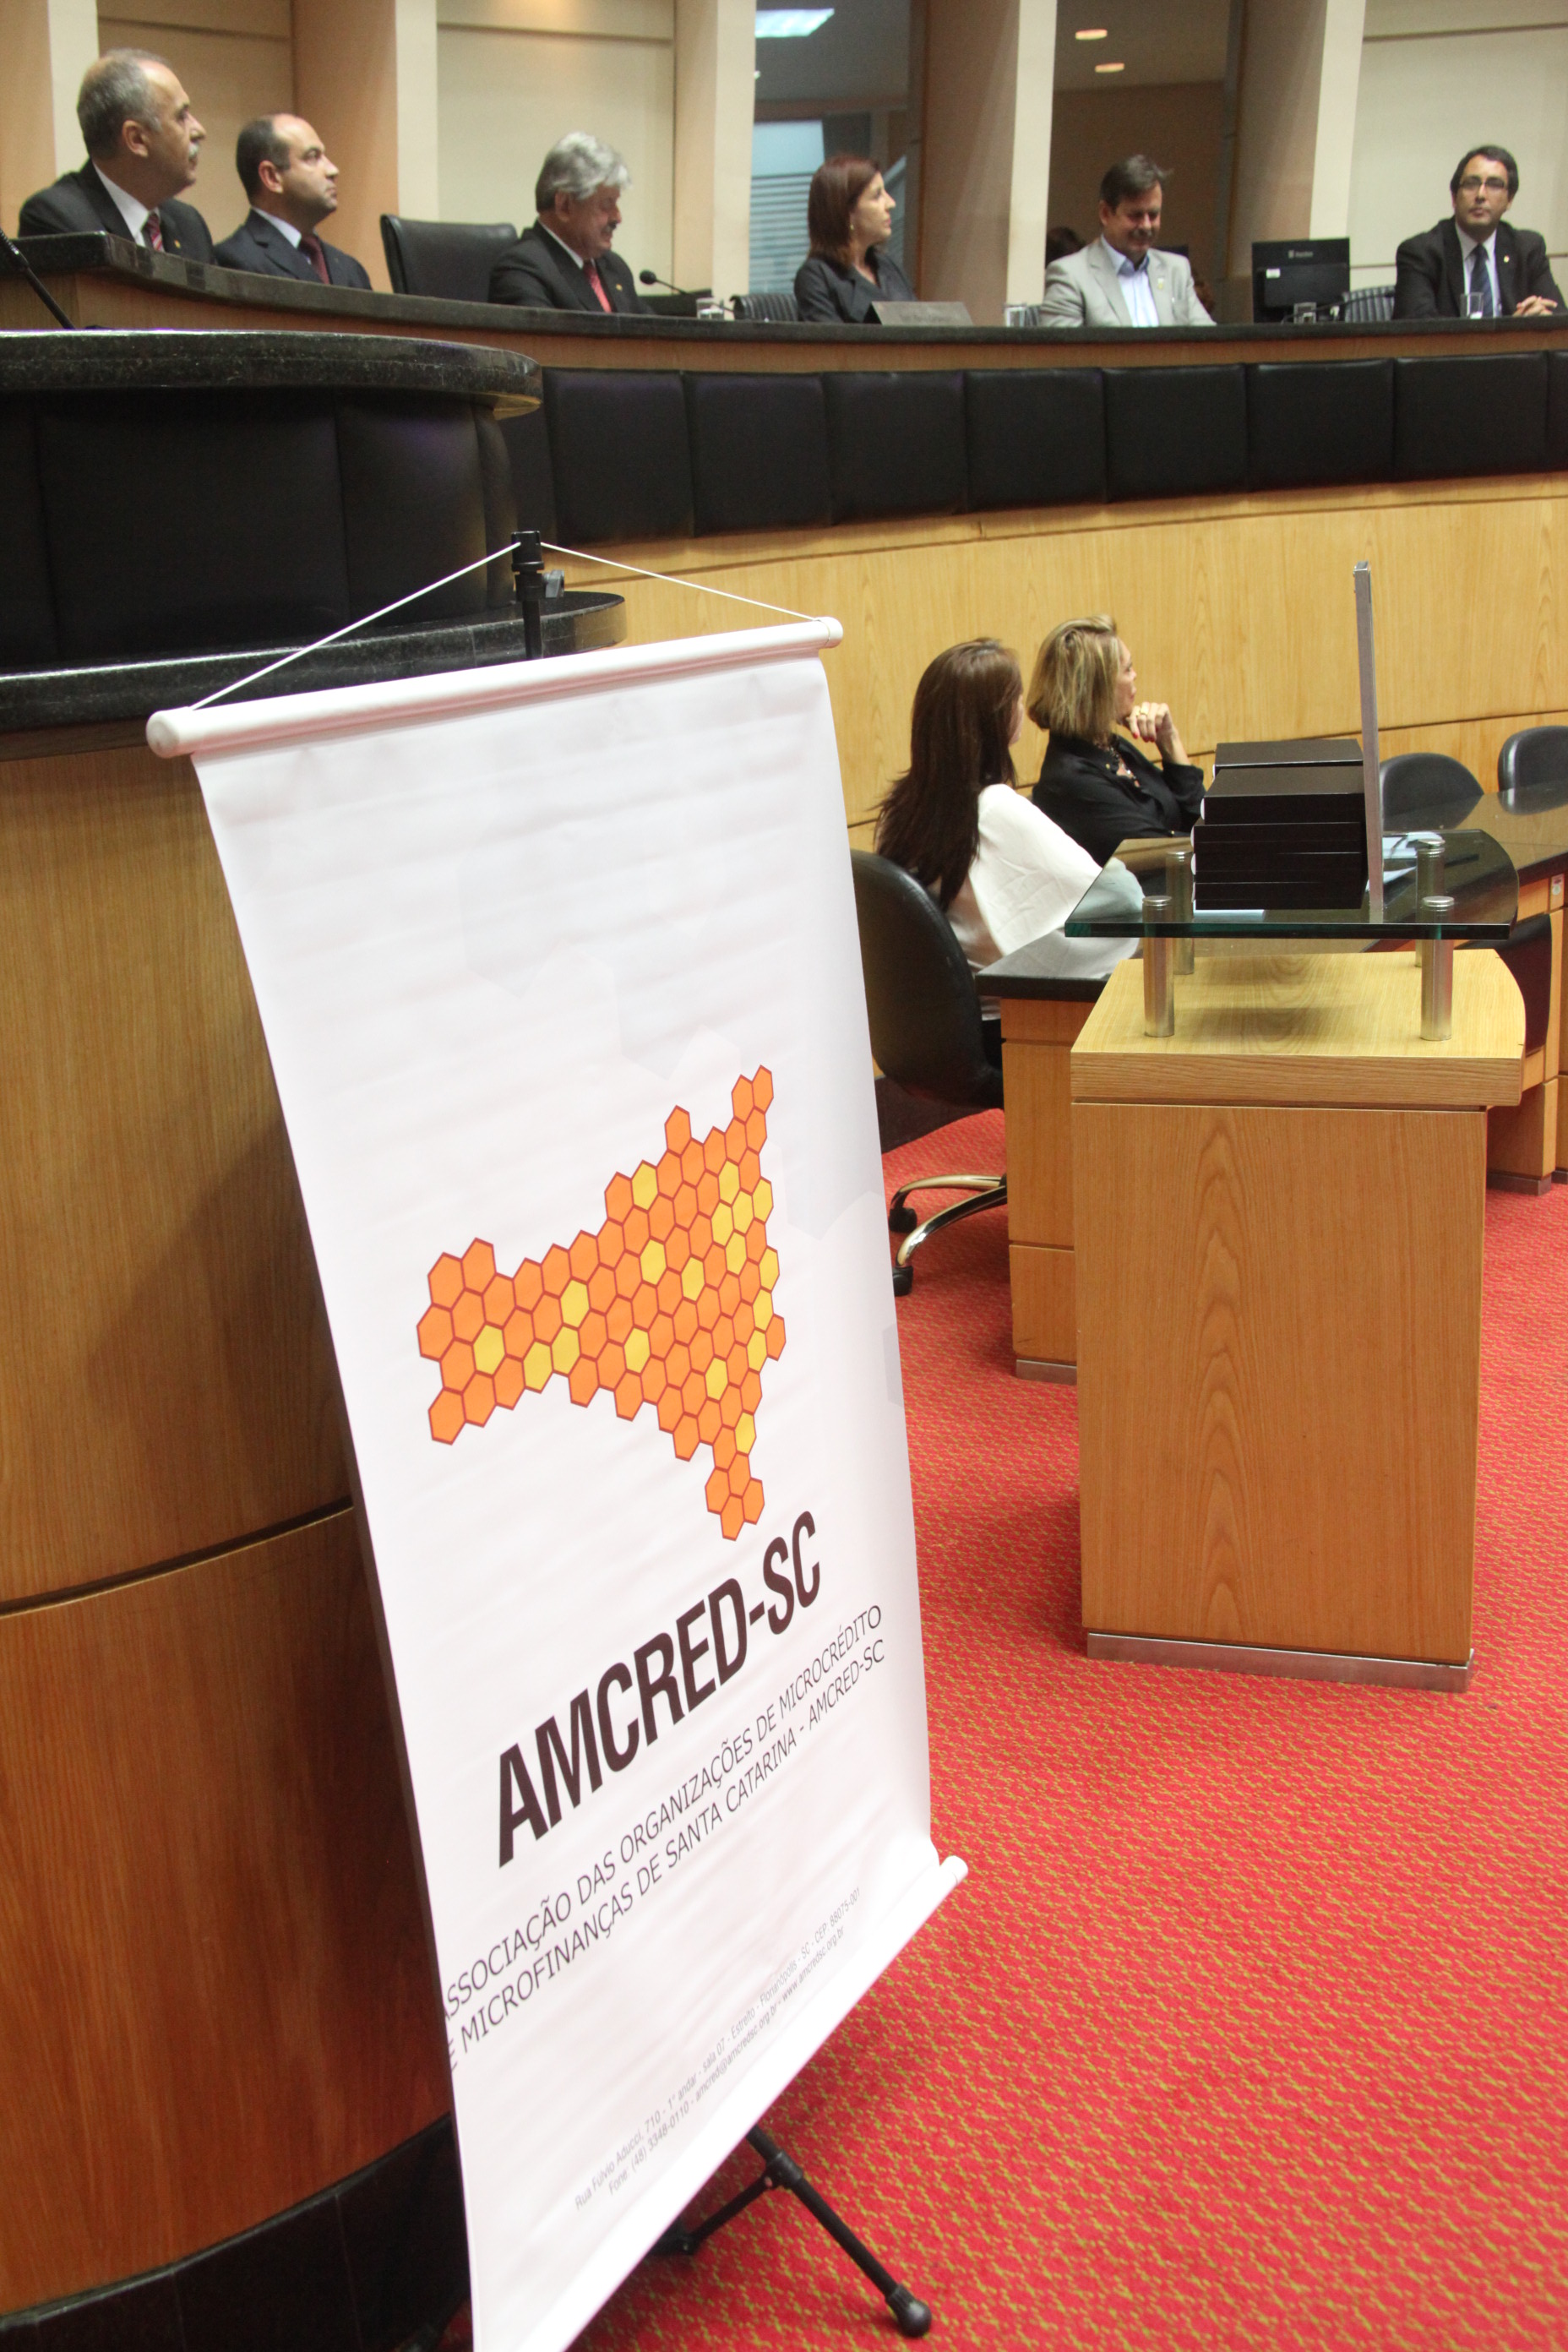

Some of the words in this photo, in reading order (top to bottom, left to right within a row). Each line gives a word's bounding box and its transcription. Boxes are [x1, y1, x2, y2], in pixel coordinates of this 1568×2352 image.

[443, 1895, 571, 2021] SSOCIAÇÃO
[577, 1850, 616, 1905] DAS
[620, 1727, 753, 1864] ORGANIZAÇÕES
[756, 1703, 776, 1743] DE
[779, 1604, 881, 1720] MICROCRÉDITO
[460, 1881, 634, 2054] MICROFINANÇAS
[636, 1853, 662, 1897] DE
[666, 1802, 722, 1869] SANTA
[726, 1727, 797, 1813] CATARINA
[809, 1638, 885, 1731] AMCRED-SC
[499, 1511, 820, 1868] AMCRED-SC
[574, 2187, 592, 2211] Rua
[645, 2110, 661, 2133] 710
[678, 2072, 697, 2101] andar
[702, 2050, 716, 2073] sala
[716, 2037, 726, 2056] 07
[731, 2007, 756, 2040] Estreito
[760, 1959, 798, 2006] Florianópolis
[801, 1941, 811, 1960] SC
[830, 1886, 861, 1928] 88075-001
[631, 2145, 647, 2173] (48)
[647, 2100, 689, 2152] 3348-0110
